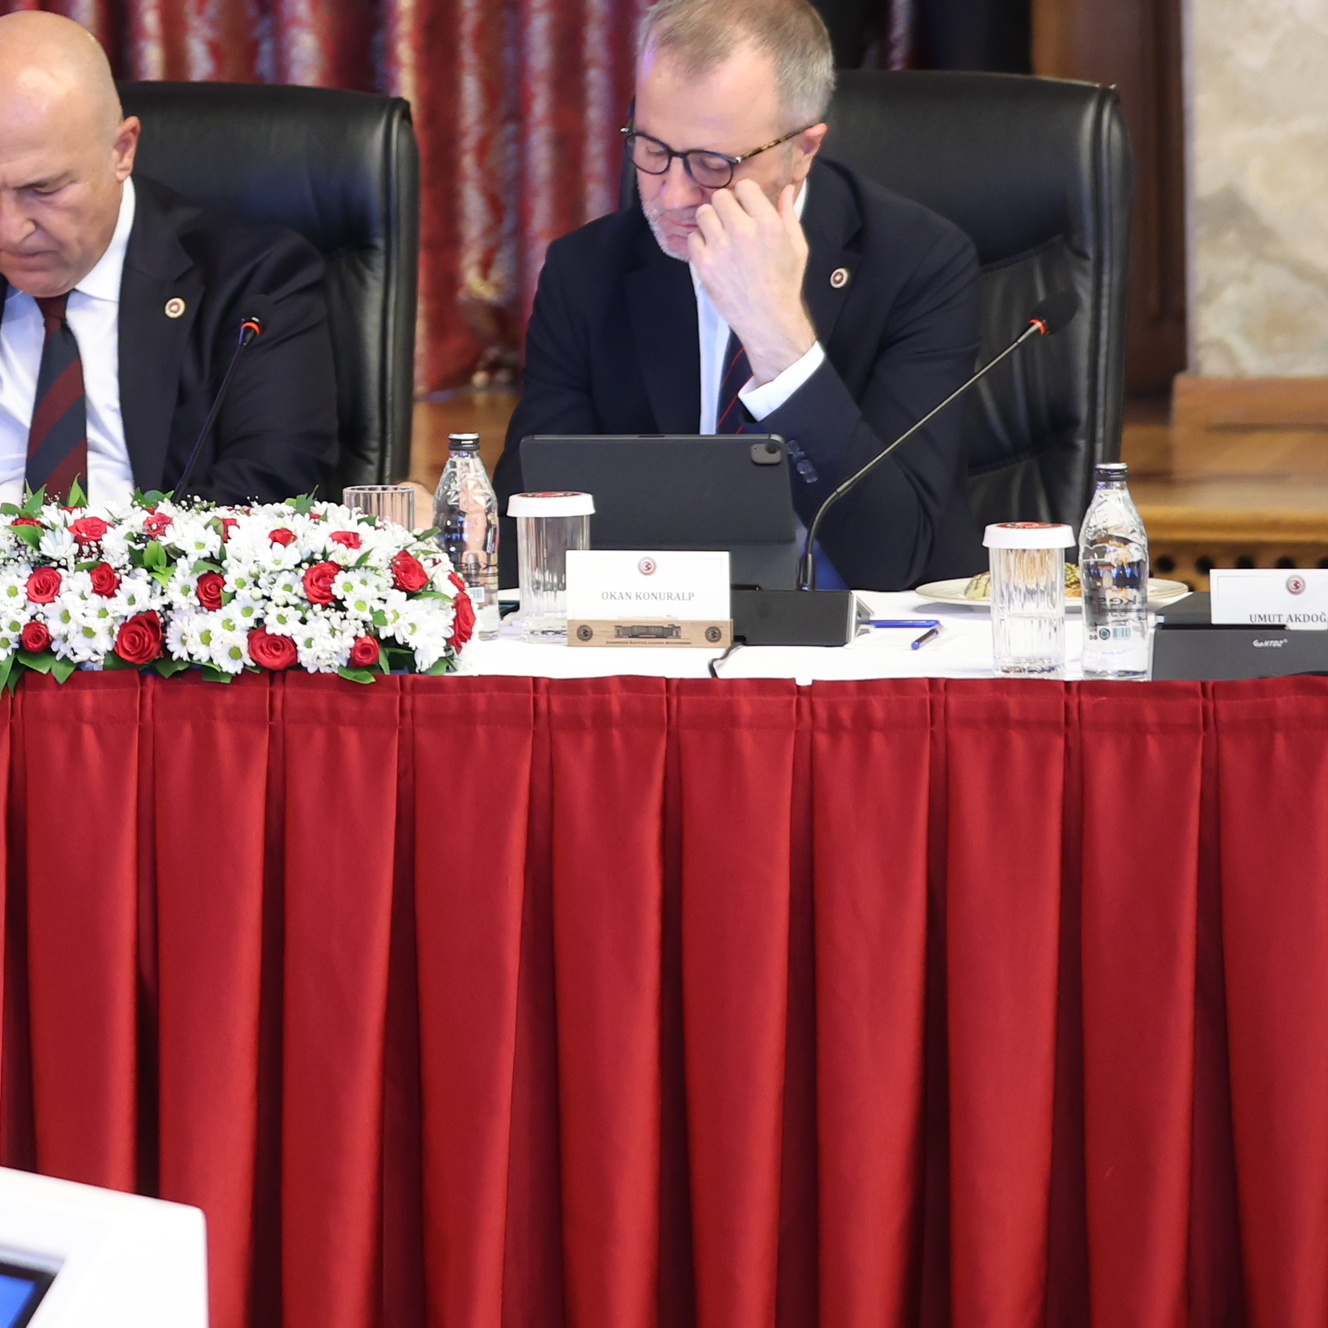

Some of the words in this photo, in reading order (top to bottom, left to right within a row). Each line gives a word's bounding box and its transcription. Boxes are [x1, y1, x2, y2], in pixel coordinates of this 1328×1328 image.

[601, 591, 632, 600] OKAN
[635, 591, 695, 601] KONURALP
[1249, 613, 1284, 623] UMUT
